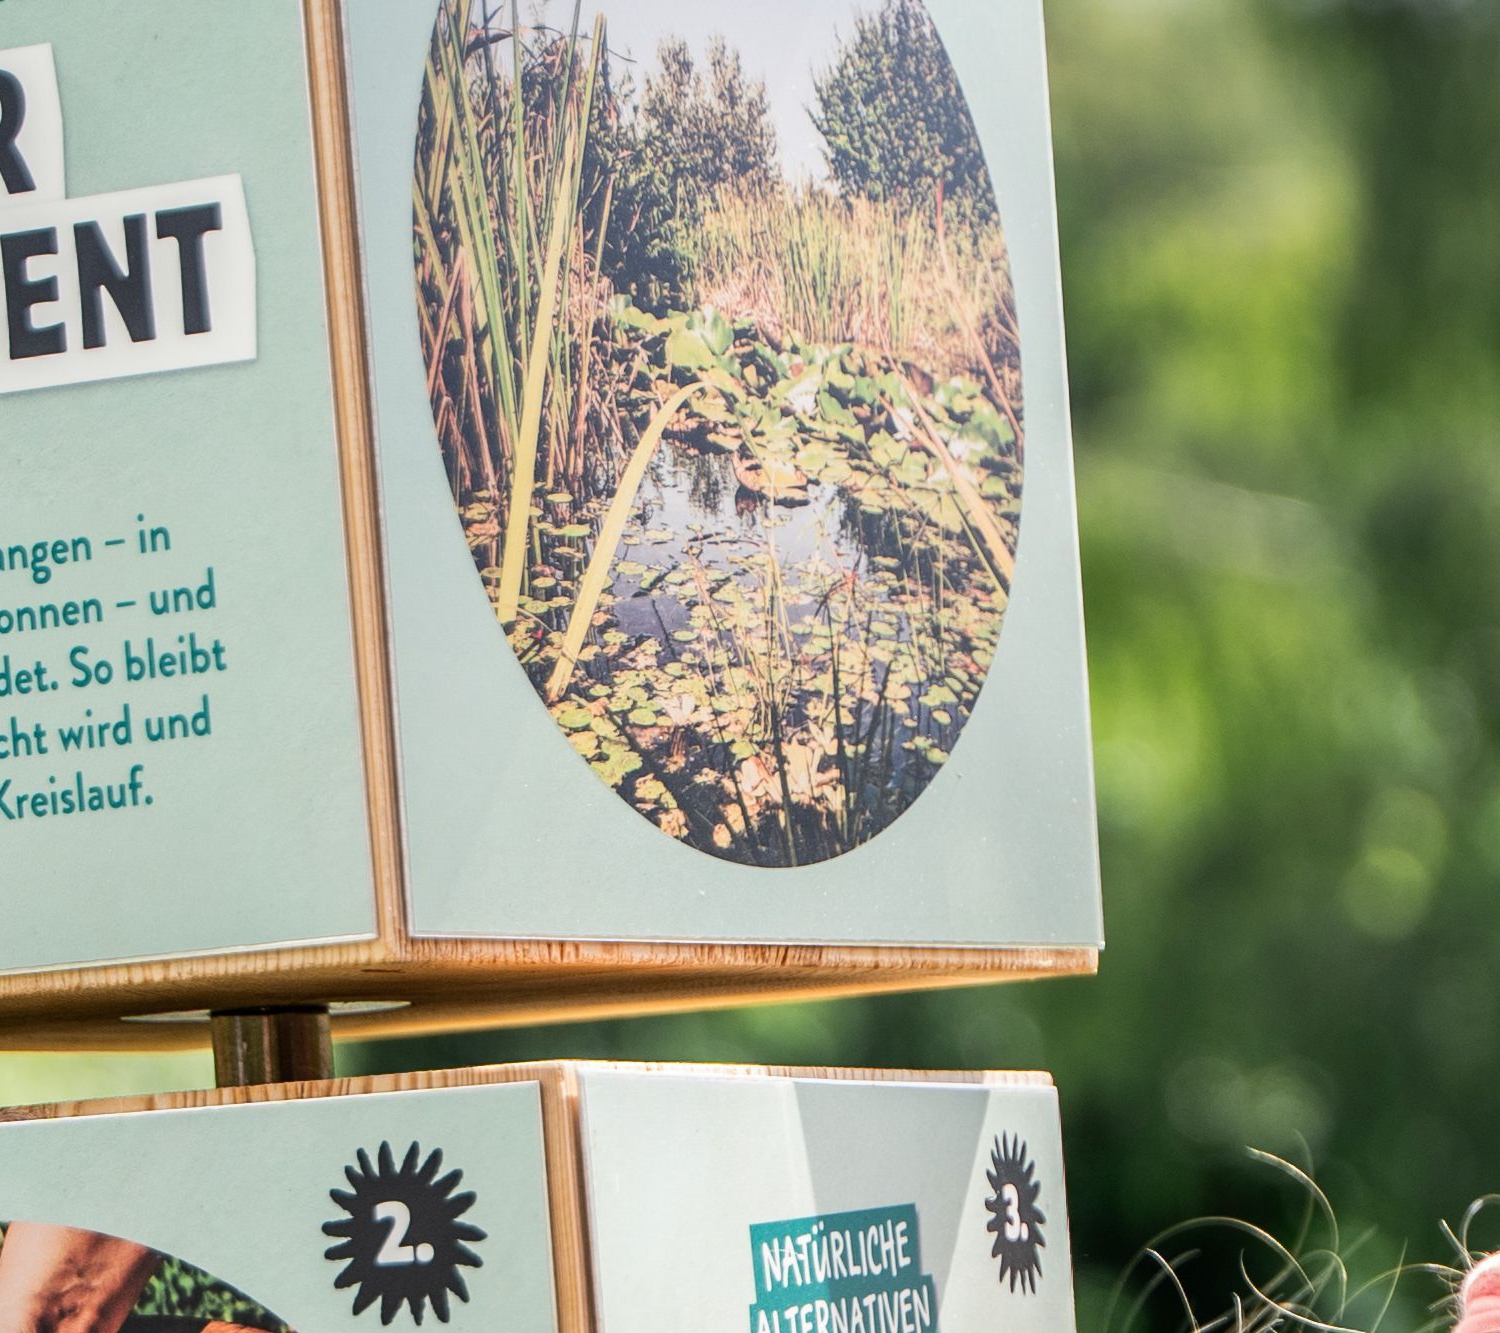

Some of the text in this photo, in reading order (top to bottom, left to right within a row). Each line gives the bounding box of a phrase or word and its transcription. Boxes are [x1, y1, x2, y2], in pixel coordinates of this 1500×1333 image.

[137, 513, 171, 554] in
[149, 567, 216, 615] und
[70, 645, 113, 688] So
[125, 633, 227, 681] bleibt
[59, 704, 132, 751] wird
[145, 694, 211, 741] und
[373, 1201, 435, 1266] 2.
[1002, 1183, 1029, 1242] 3.
[762, 1219, 911, 1291] NATÜRLICHE
